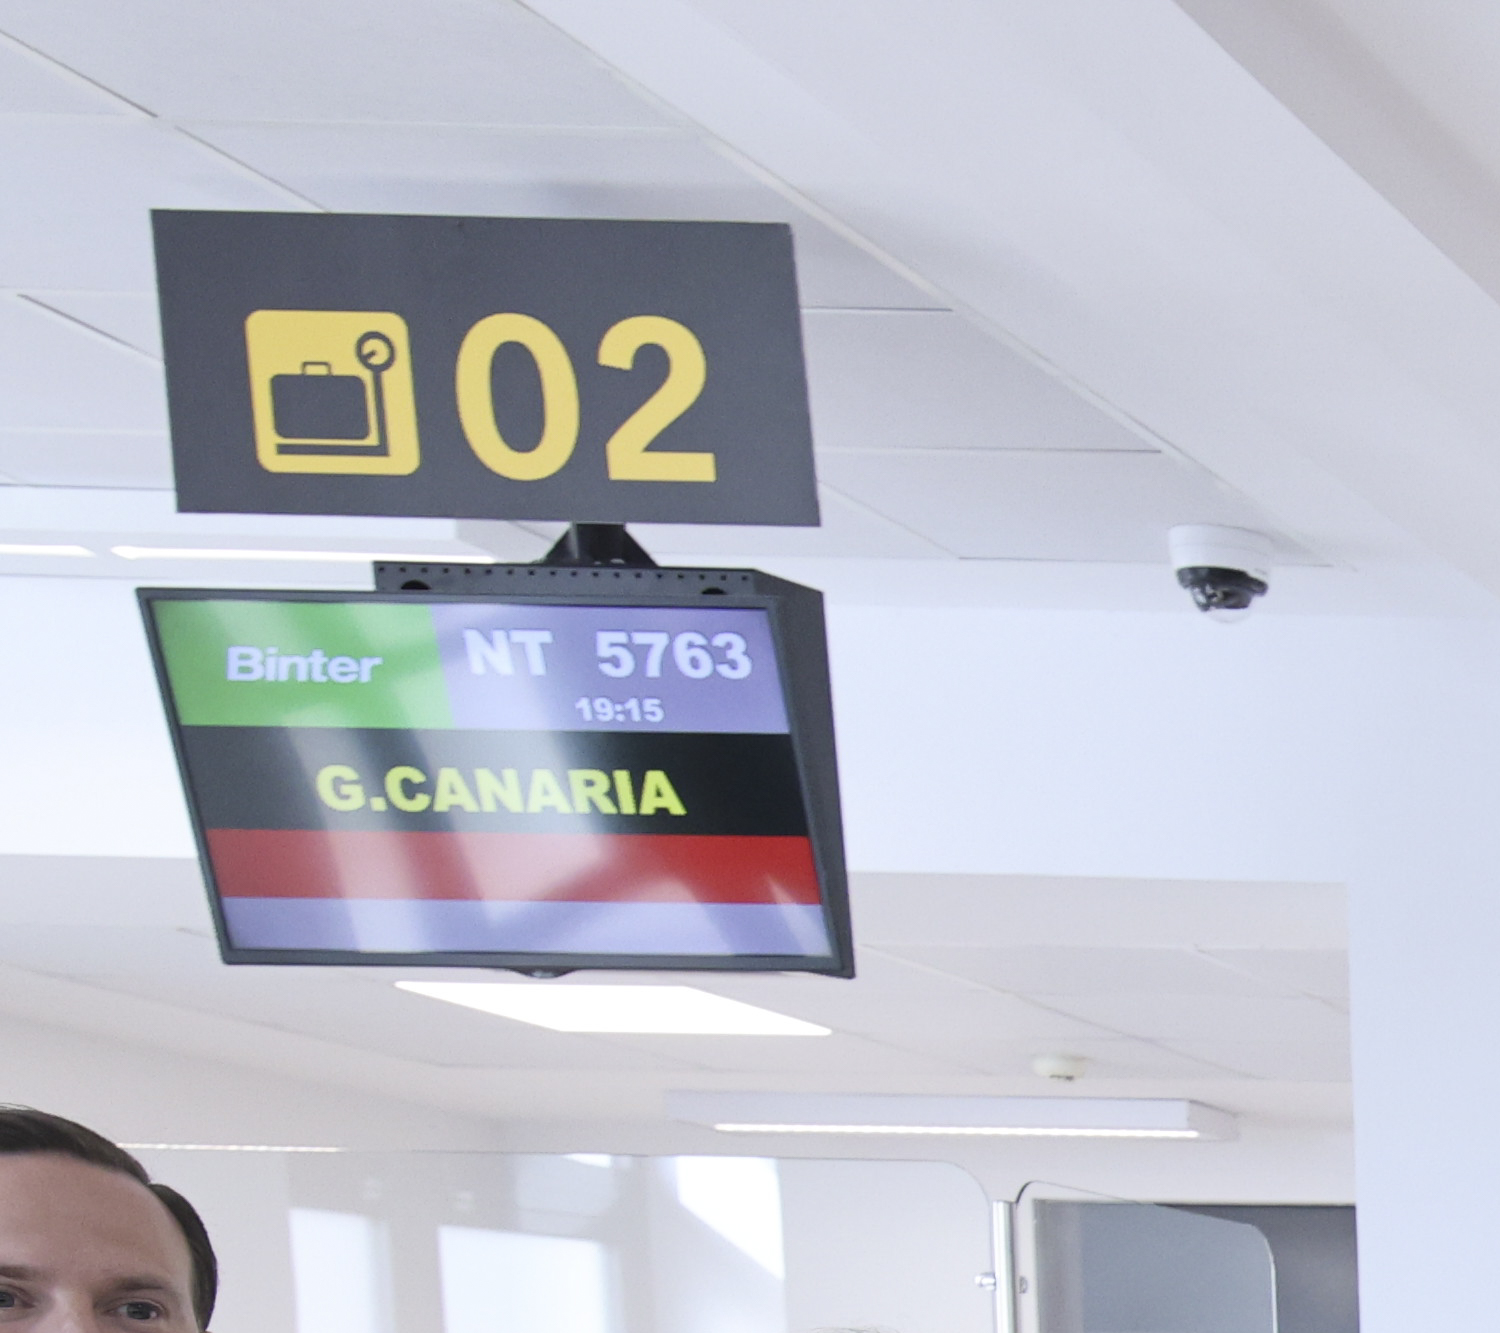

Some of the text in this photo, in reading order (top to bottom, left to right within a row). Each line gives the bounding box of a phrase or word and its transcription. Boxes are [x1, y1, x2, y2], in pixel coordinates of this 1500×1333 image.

[454, 311, 717, 484] 02
[225, 643, 382, 685] Binter
[463, 629, 753, 681] NT 5763
[574, 696, 665, 724] 19:15
[315, 764, 686, 817] G.CANARIA
